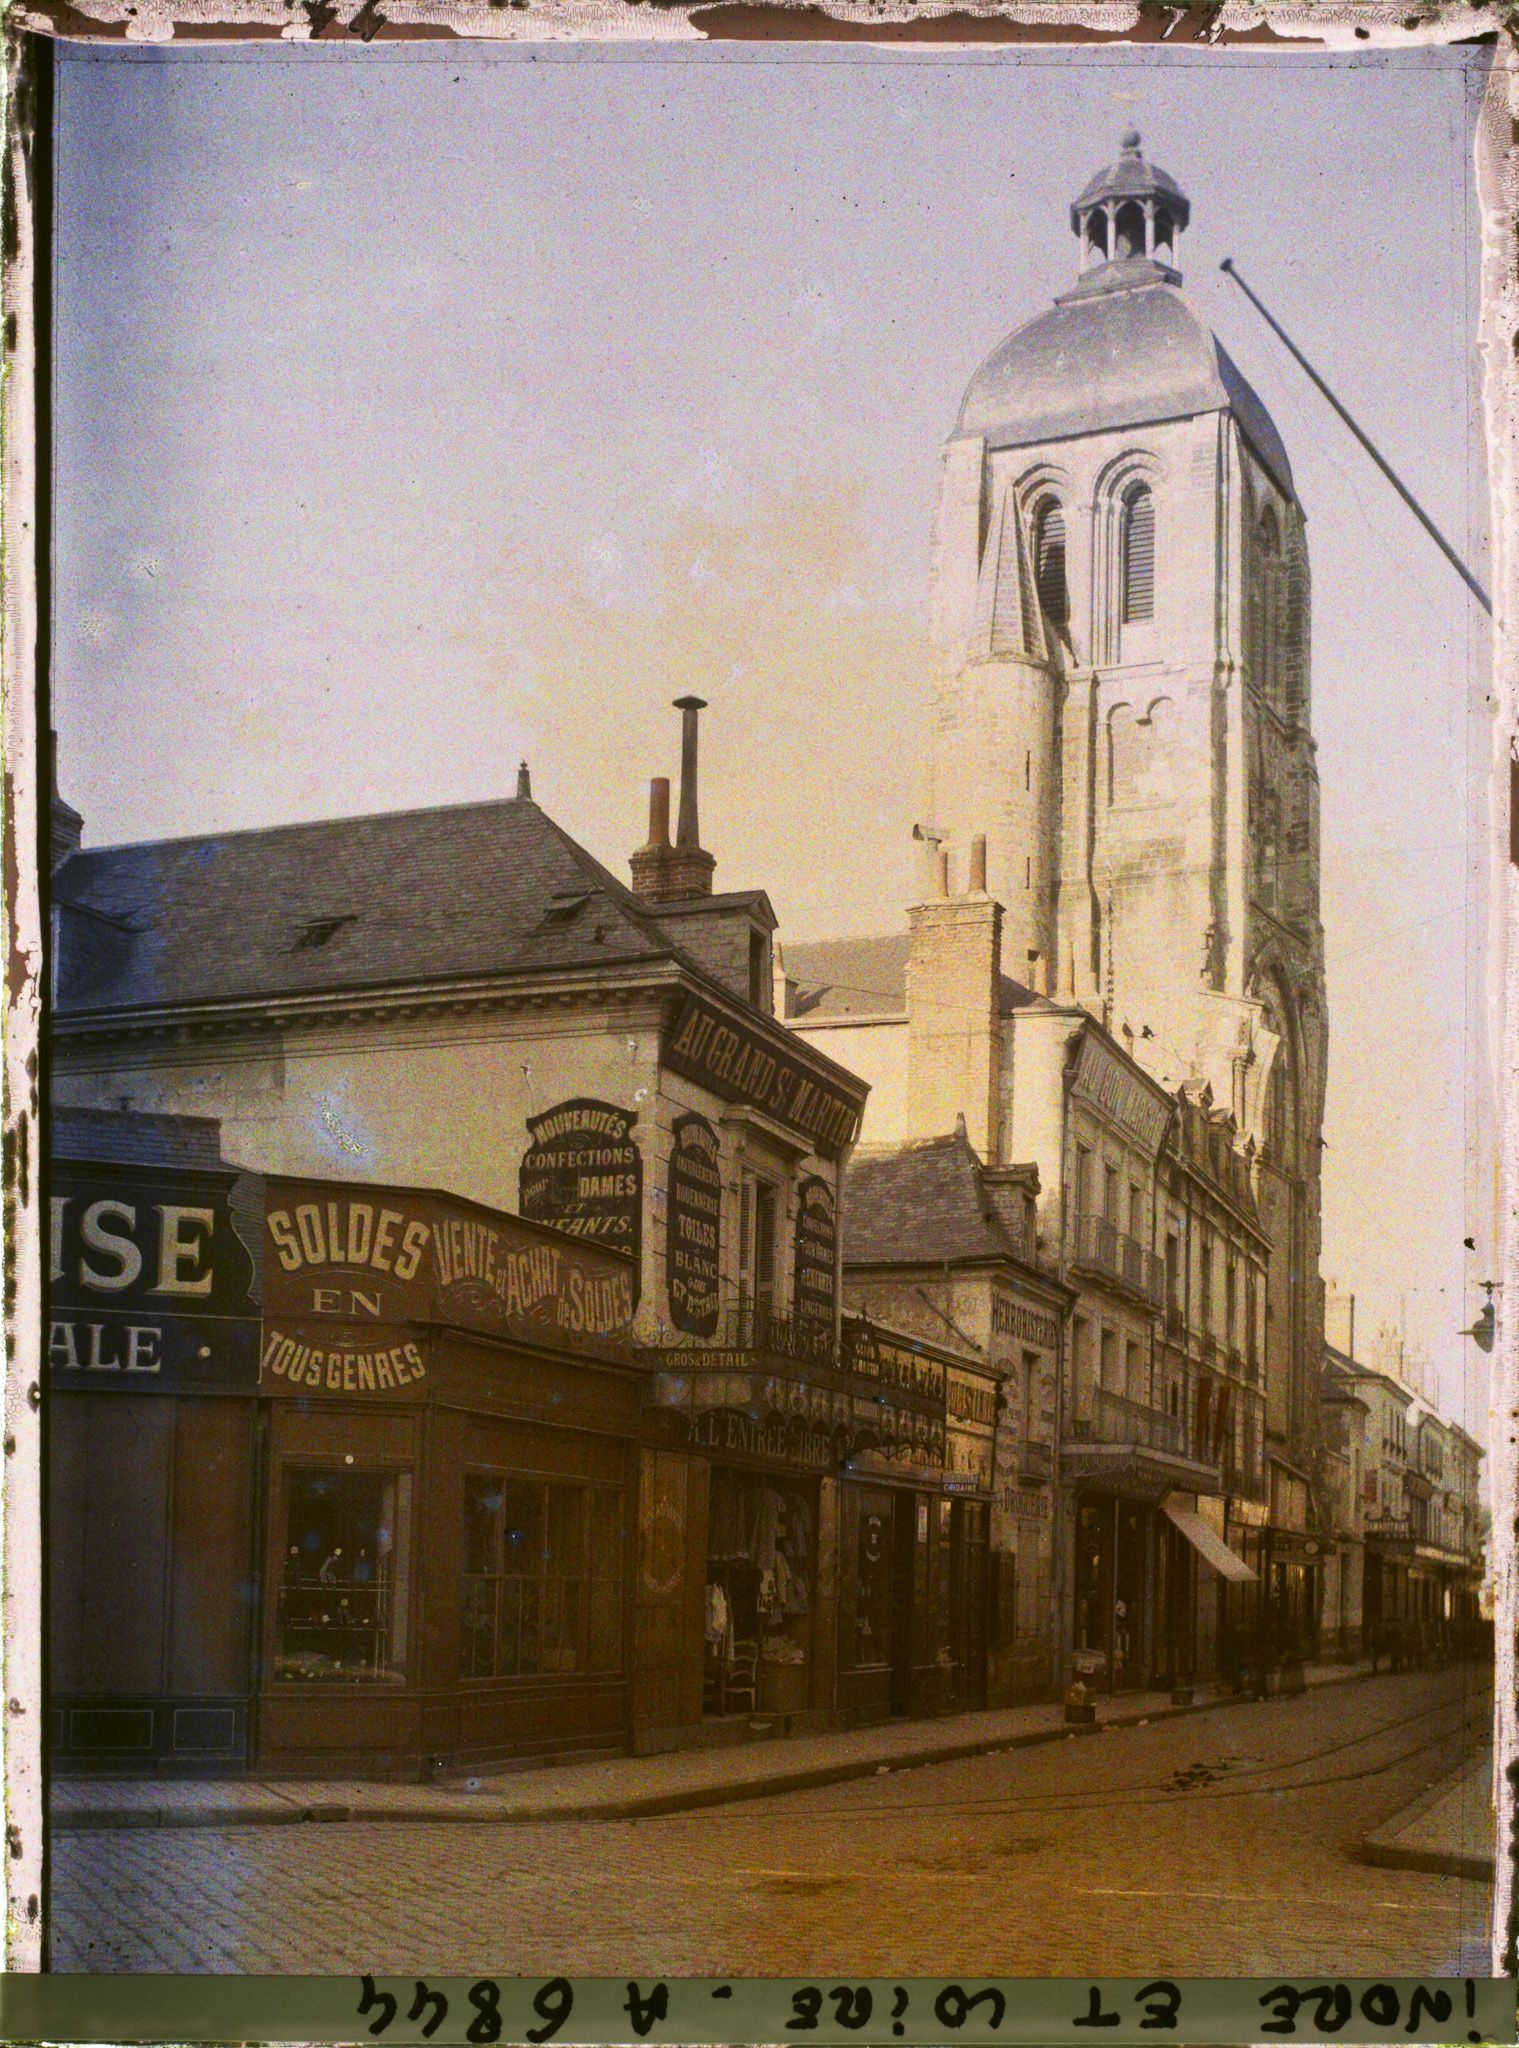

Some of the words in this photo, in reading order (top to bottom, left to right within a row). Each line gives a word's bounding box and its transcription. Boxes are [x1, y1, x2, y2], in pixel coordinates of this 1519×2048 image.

[673, 1008, 715, 1062] AU
[706, 1025, 777, 1100] GRAND
[788, 1078, 858, 1150] MARTIN
[533, 1109, 627, 1145] NOUVEAUTÉS
[524, 1147, 634, 1169] CONFECTIONS
[579, 1174, 637, 1199] DAMES
[267, 1202, 430, 1280] SOLDES
[678, 1213, 716, 1249] TOILES
[432, 1219, 499, 1286] VENTE
[505, 1245, 561, 1317] ACHAT
[570, 1269, 633, 1333] SOLDES
[675, 1249, 718, 1279] BLANC
[311, 1289, 382, 1316] EN
[262, 1330, 324, 1386] TOUS
[326, 1342, 425, 1391] GENRES
[666, 1353, 694, 1367] GROS
[356, 1974, 574, 2045] 6844
[624, 1981, 670, 2037] A
[1072, 1980, 1182, 2030] ET
